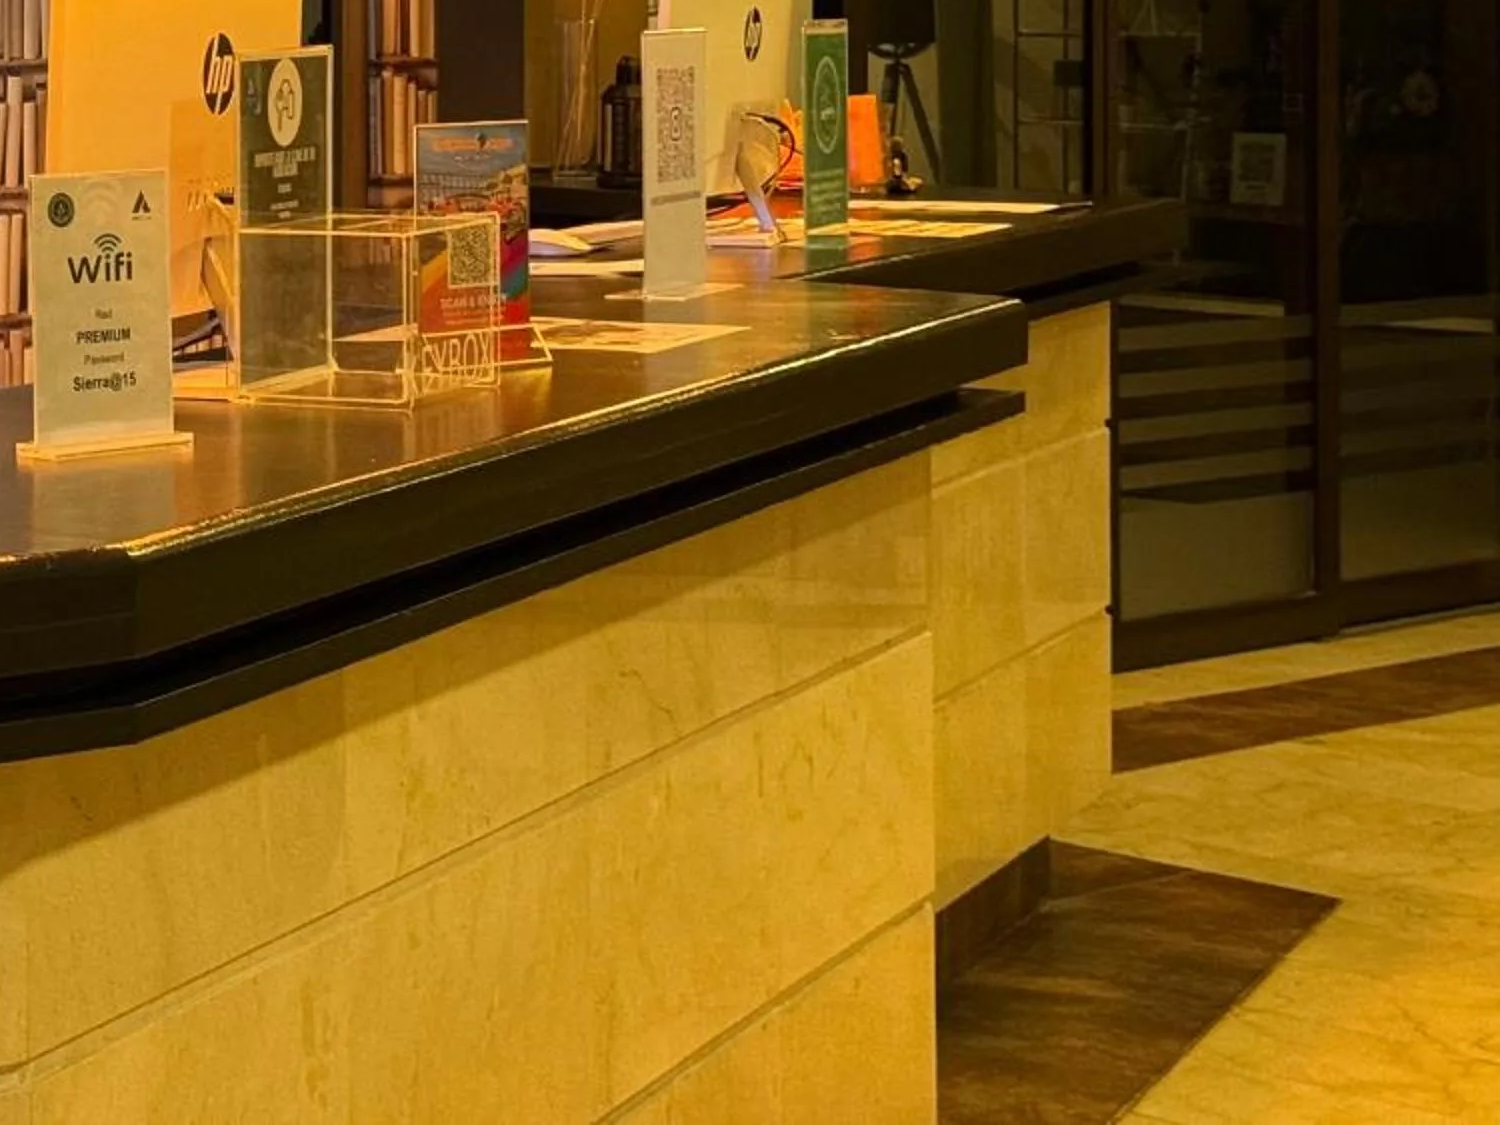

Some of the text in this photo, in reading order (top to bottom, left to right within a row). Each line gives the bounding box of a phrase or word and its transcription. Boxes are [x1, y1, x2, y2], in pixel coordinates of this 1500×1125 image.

[204, 32, 234, 115] hp
[67, 251, 132, 284] Wifi
[76, 326, 131, 345] PREMIUM
[73, 370, 137, 392] Sierra@15
